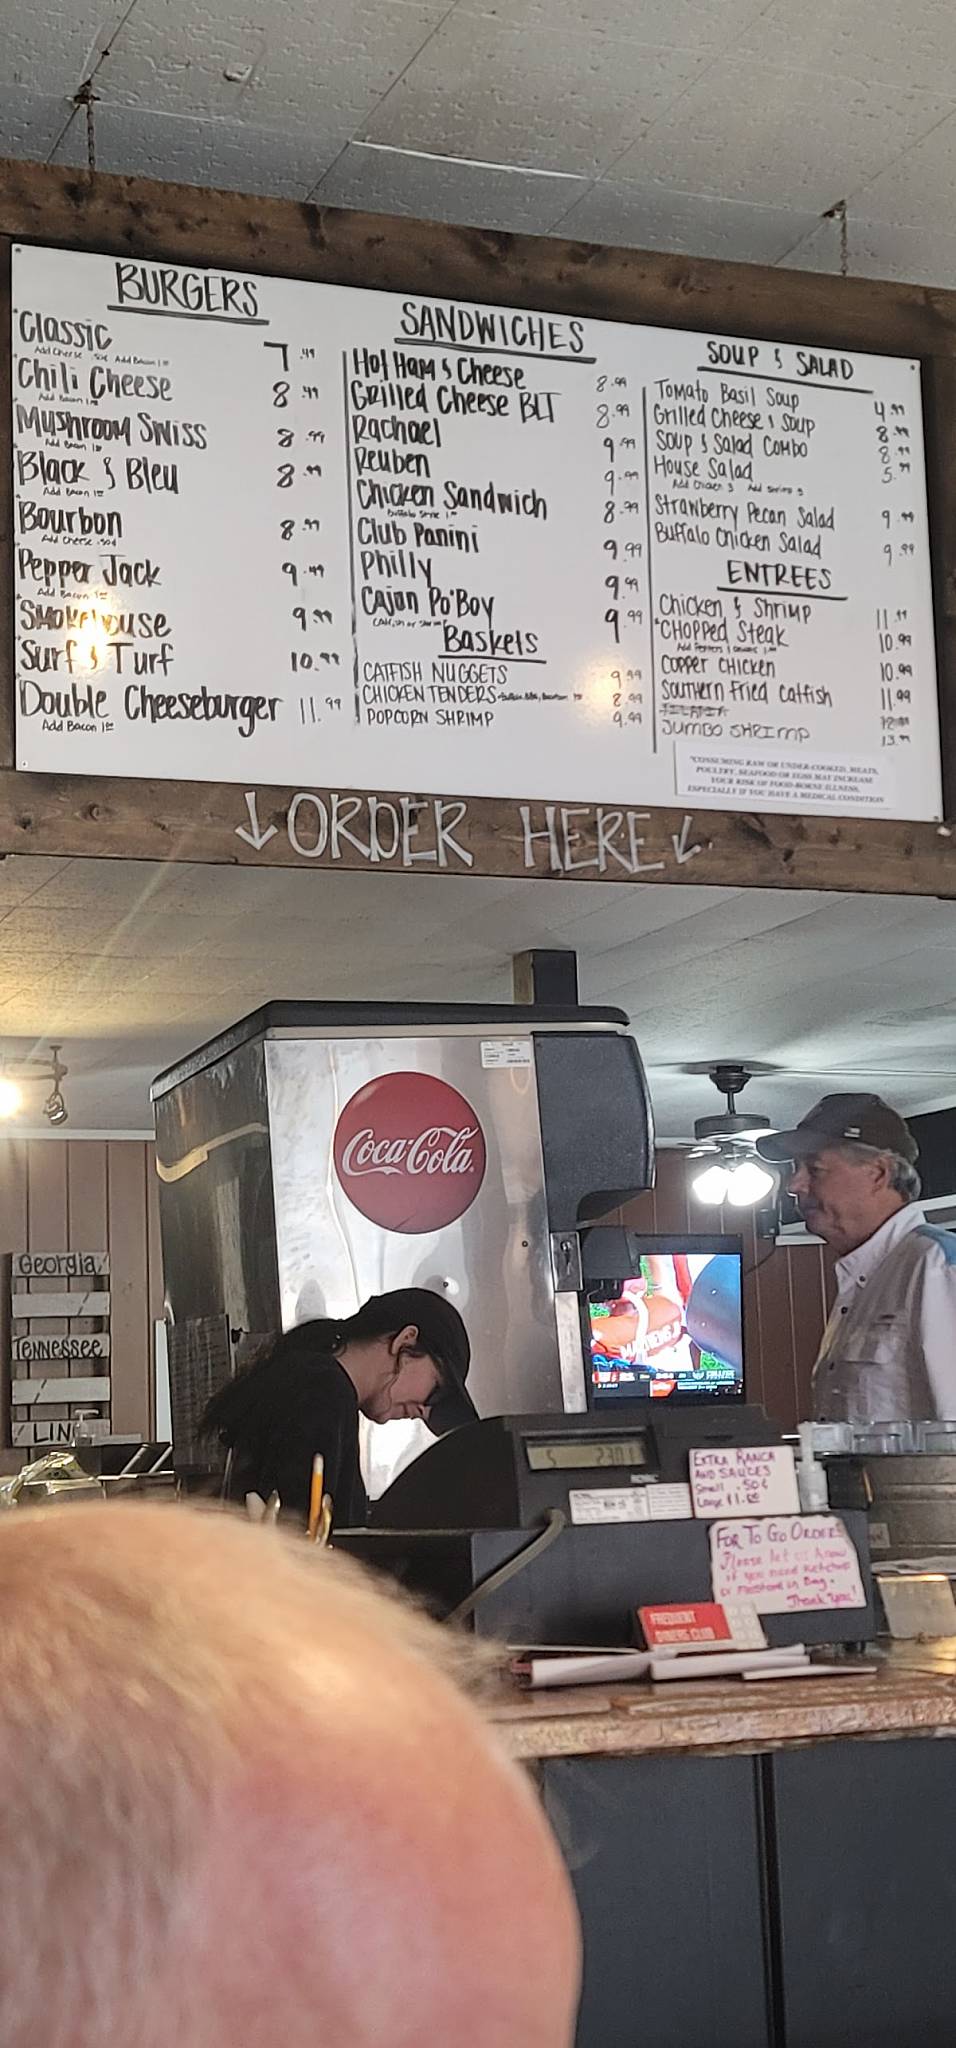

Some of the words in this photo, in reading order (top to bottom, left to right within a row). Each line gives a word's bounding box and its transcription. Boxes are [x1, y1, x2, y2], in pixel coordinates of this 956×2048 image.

[115, 262, 259, 316] BURGERS
[19, 310, 112, 351] Classic
[400, 302, 584, 353] SANDWICHES
[393, 351, 435, 381] Ham
[457, 357, 526, 389] Cheese
[707, 341, 759, 367] SOUP
[796, 351, 854, 380] SALAD
[18, 357, 78, 394] Chili
[90, 366, 173, 401] Cheese
[654, 378, 708, 403] Tomato
[721, 383, 755, 406] Basil
[766, 387, 799, 413] Soup
[351, 380, 429, 413] Grilled
[436, 385, 509, 416] Cheese
[519, 392, 561, 423] BLT
[137, 412, 207, 449] Swiss
[352, 415, 441, 447] Rachael
[654, 404, 705, 427] Grilled
[711, 407, 763, 429] Cheese
[782, 413, 815, 438] Soup
[354, 446, 430, 478] Reuben
[713, 432, 753, 459] Salad
[17, 450, 90, 485] Black
[125, 456, 179, 494] Bleu
[654, 455, 700, 477] House
[708, 457, 753, 482] Salad
[356, 479, 434, 509] Chicken
[443, 480, 547, 520] Sandwich
[655, 494, 738, 531] Strawberry
[747, 502, 786, 526] Pecan
[798, 506, 835, 531] Salad
[18, 501, 122, 537] Bourbon
[357, 517, 407, 545] Club
[413, 521, 479, 553] Panini
[655, 522, 710, 545] Buffalo
[716, 527, 770, 550] Chicken
[779, 532, 821, 559] Salad
[18, 548, 95, 588] Pepper
[99, 554, 162, 588] Jack
[361, 549, 431, 588] Philly
[727, 560, 831, 590] ENTREES
[361, 586, 419, 616] Cajun
[660, 593, 722, 618] Chicken
[754, 597, 811, 624] Shrimp
[444, 620, 538, 655] Baskets
[737, 620, 788, 647] Steak
[20, 640, 78, 674] Surf
[106, 643, 174, 676] Turf
[363, 661, 422, 683] CATFISH
[432, 662, 507, 685] NUGGETS
[20, 680, 109, 718] Double
[124, 684, 284, 737] Cheeseburger
[362, 684, 424, 704] CHICKEN
[428, 684, 497, 704] TENDERS
[730, 681, 768, 704] Fried
[42, 720, 63, 732] Add
[67, 721, 97, 732] Bacon
[367, 708, 429, 727] POPCORN
[435, 709, 494, 728] SHRIMP
[287, 792, 474, 868] ORDER
[519, 806, 666, 874] HERE
[341, 1126, 479, 1176] Coca-Cola
[19, 1254, 97, 1275] Georgia
[695, 1469, 716, 1479] AND
[719, 1465, 771, 1479] SAUCES
[717, 1527, 743, 1550] FOR
